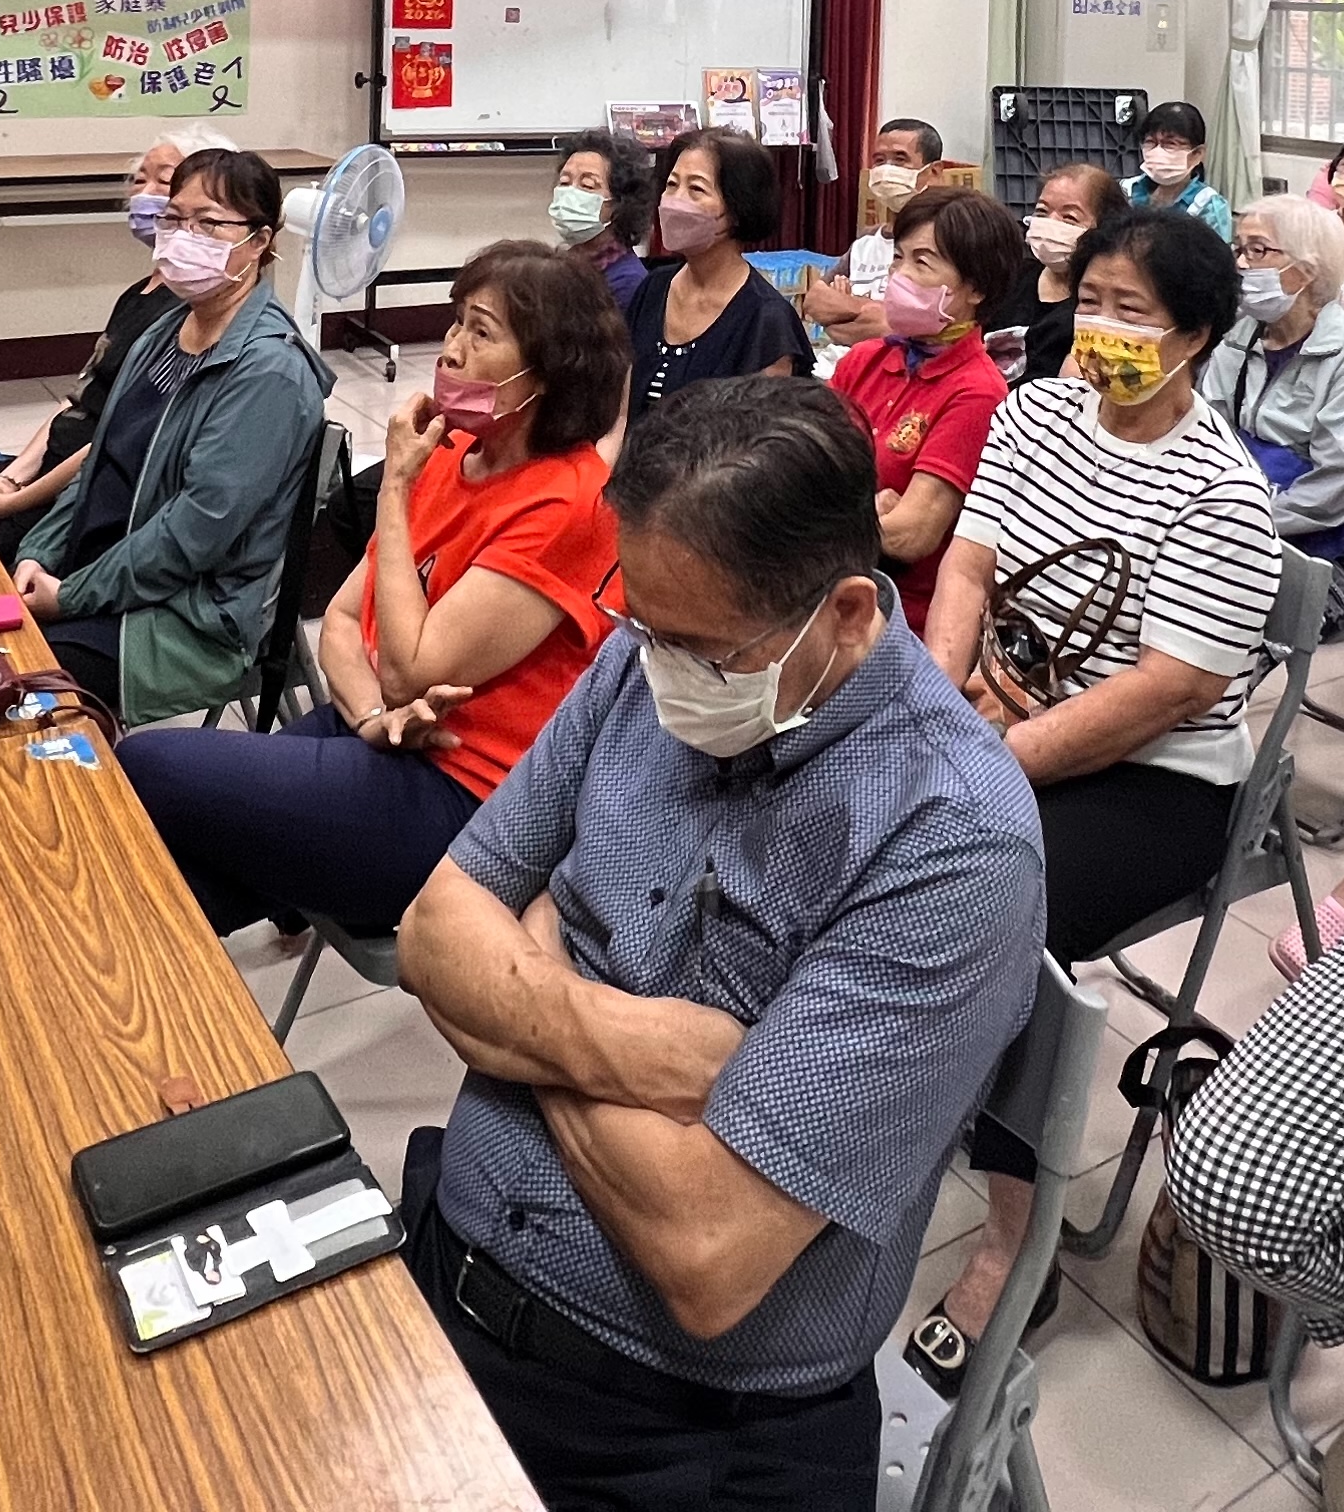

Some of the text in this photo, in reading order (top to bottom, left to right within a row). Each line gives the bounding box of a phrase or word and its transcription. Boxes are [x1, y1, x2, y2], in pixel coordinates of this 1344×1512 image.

[102, 35, 150, 66] 防治
[163, 21, 229, 62] 性侵害
[140, 56, 244, 94] 保護老人
